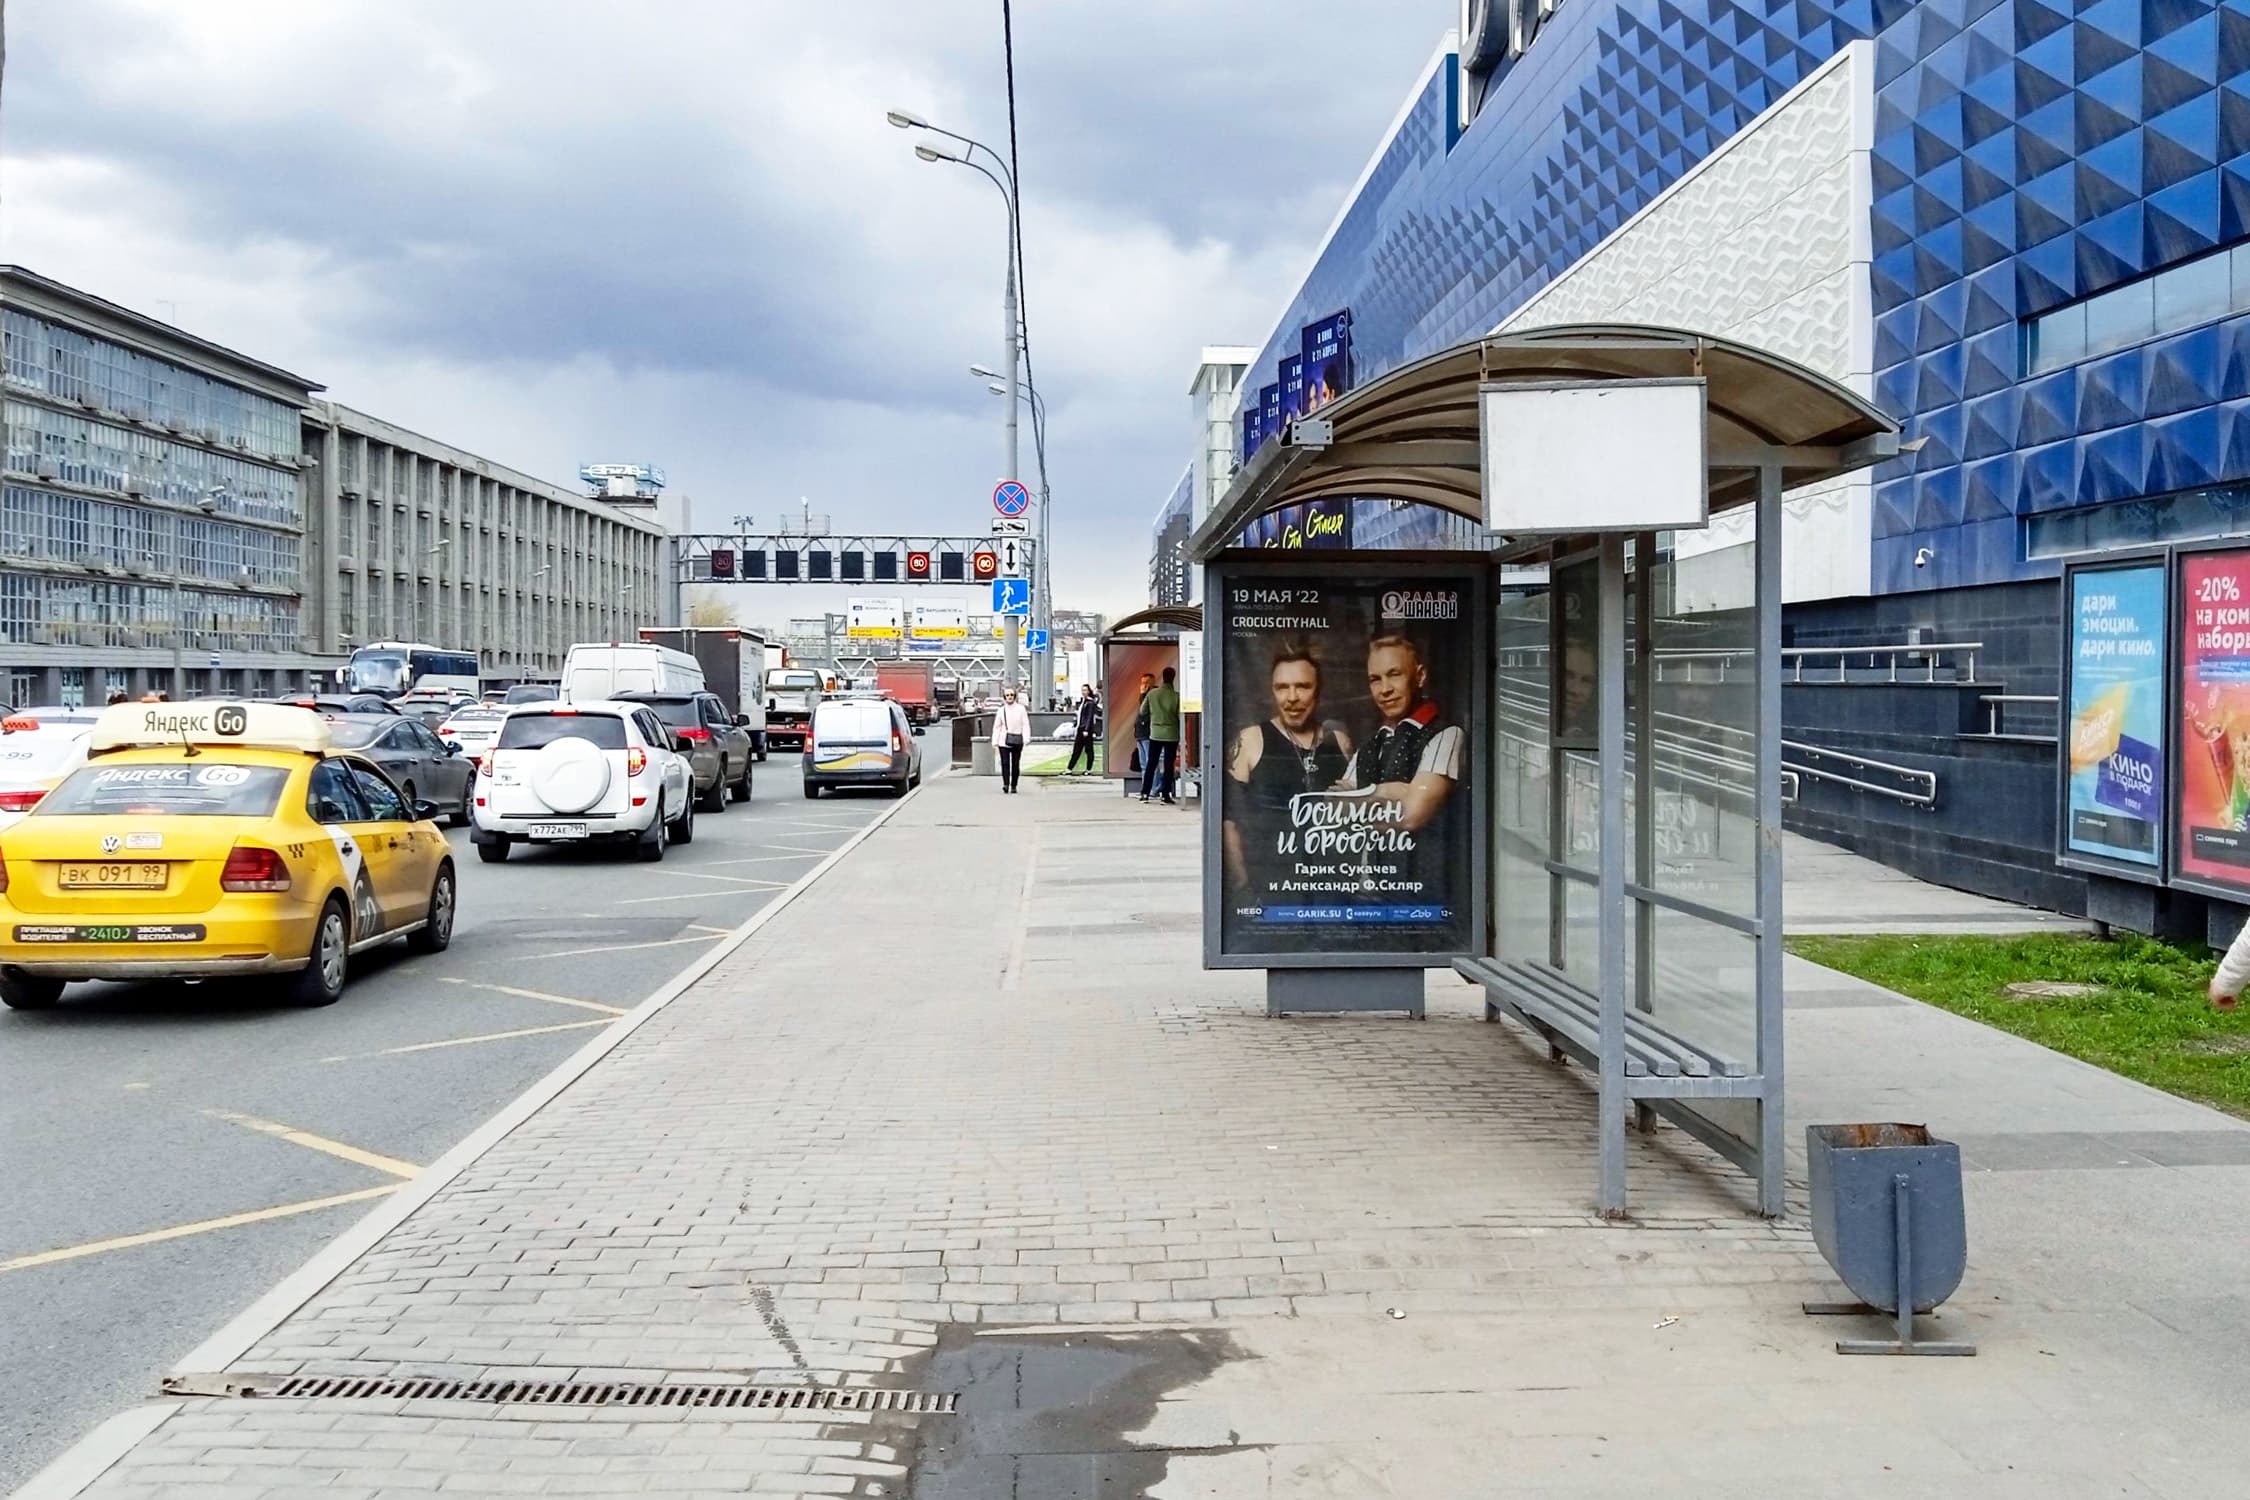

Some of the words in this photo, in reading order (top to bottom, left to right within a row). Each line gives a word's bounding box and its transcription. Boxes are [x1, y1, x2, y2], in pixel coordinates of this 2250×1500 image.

[1232, 589, 1249, 603] 19
[1254, 589, 1292, 603] МАЯ
[2195, 576, 2240, 602] -20%
[1403, 600, 1458, 619] ШАНСОН
[2081, 595, 2117, 617] дари
[1232, 616, 1275, 628] CROCUS
[1276, 617, 1299, 628] CITY
[1300, 617, 1330, 629] HALL
[2196, 608, 2213, 625] на
[2082, 617, 2140, 636] эмоции.
[2080, 639, 2116, 661] дари
[2119, 639, 2156, 657] кино.
[144, 711, 209, 734] Яндекс
[217, 709, 244, 732] Go
[92, 768, 192, 784] Яндекс
[206, 767, 240, 782] Go
[2109, 753, 2153, 784] КИНО
[1288, 783, 1405, 828] Боцман
[1278, 831, 1298, 854] и
[1304, 823, 1416, 856] бродяга
[68, 868, 91, 882] ВК
[99, 866, 133, 882] 091
[142, 865, 161, 878] 99
[1295, 863, 1336, 877] Гарик
[1339, 863, 1398, 877] Сукачев
[1269, 882, 1278, 891] и
[1281, 879, 1360, 893] Александр
[1362, 879, 1424, 893] Ф.Скляр
[1236, 907, 1263, 915] НЕБО
[1297, 909, 1342, 918] GARIK.SU
[20, 926, 76, 934] ПРИГЛАШАЕМ
[20, 933, 68, 941] ВОДИТЕЛЕЙ
[136, 932, 197, 941] БЕСПЛАТНЫЙ
